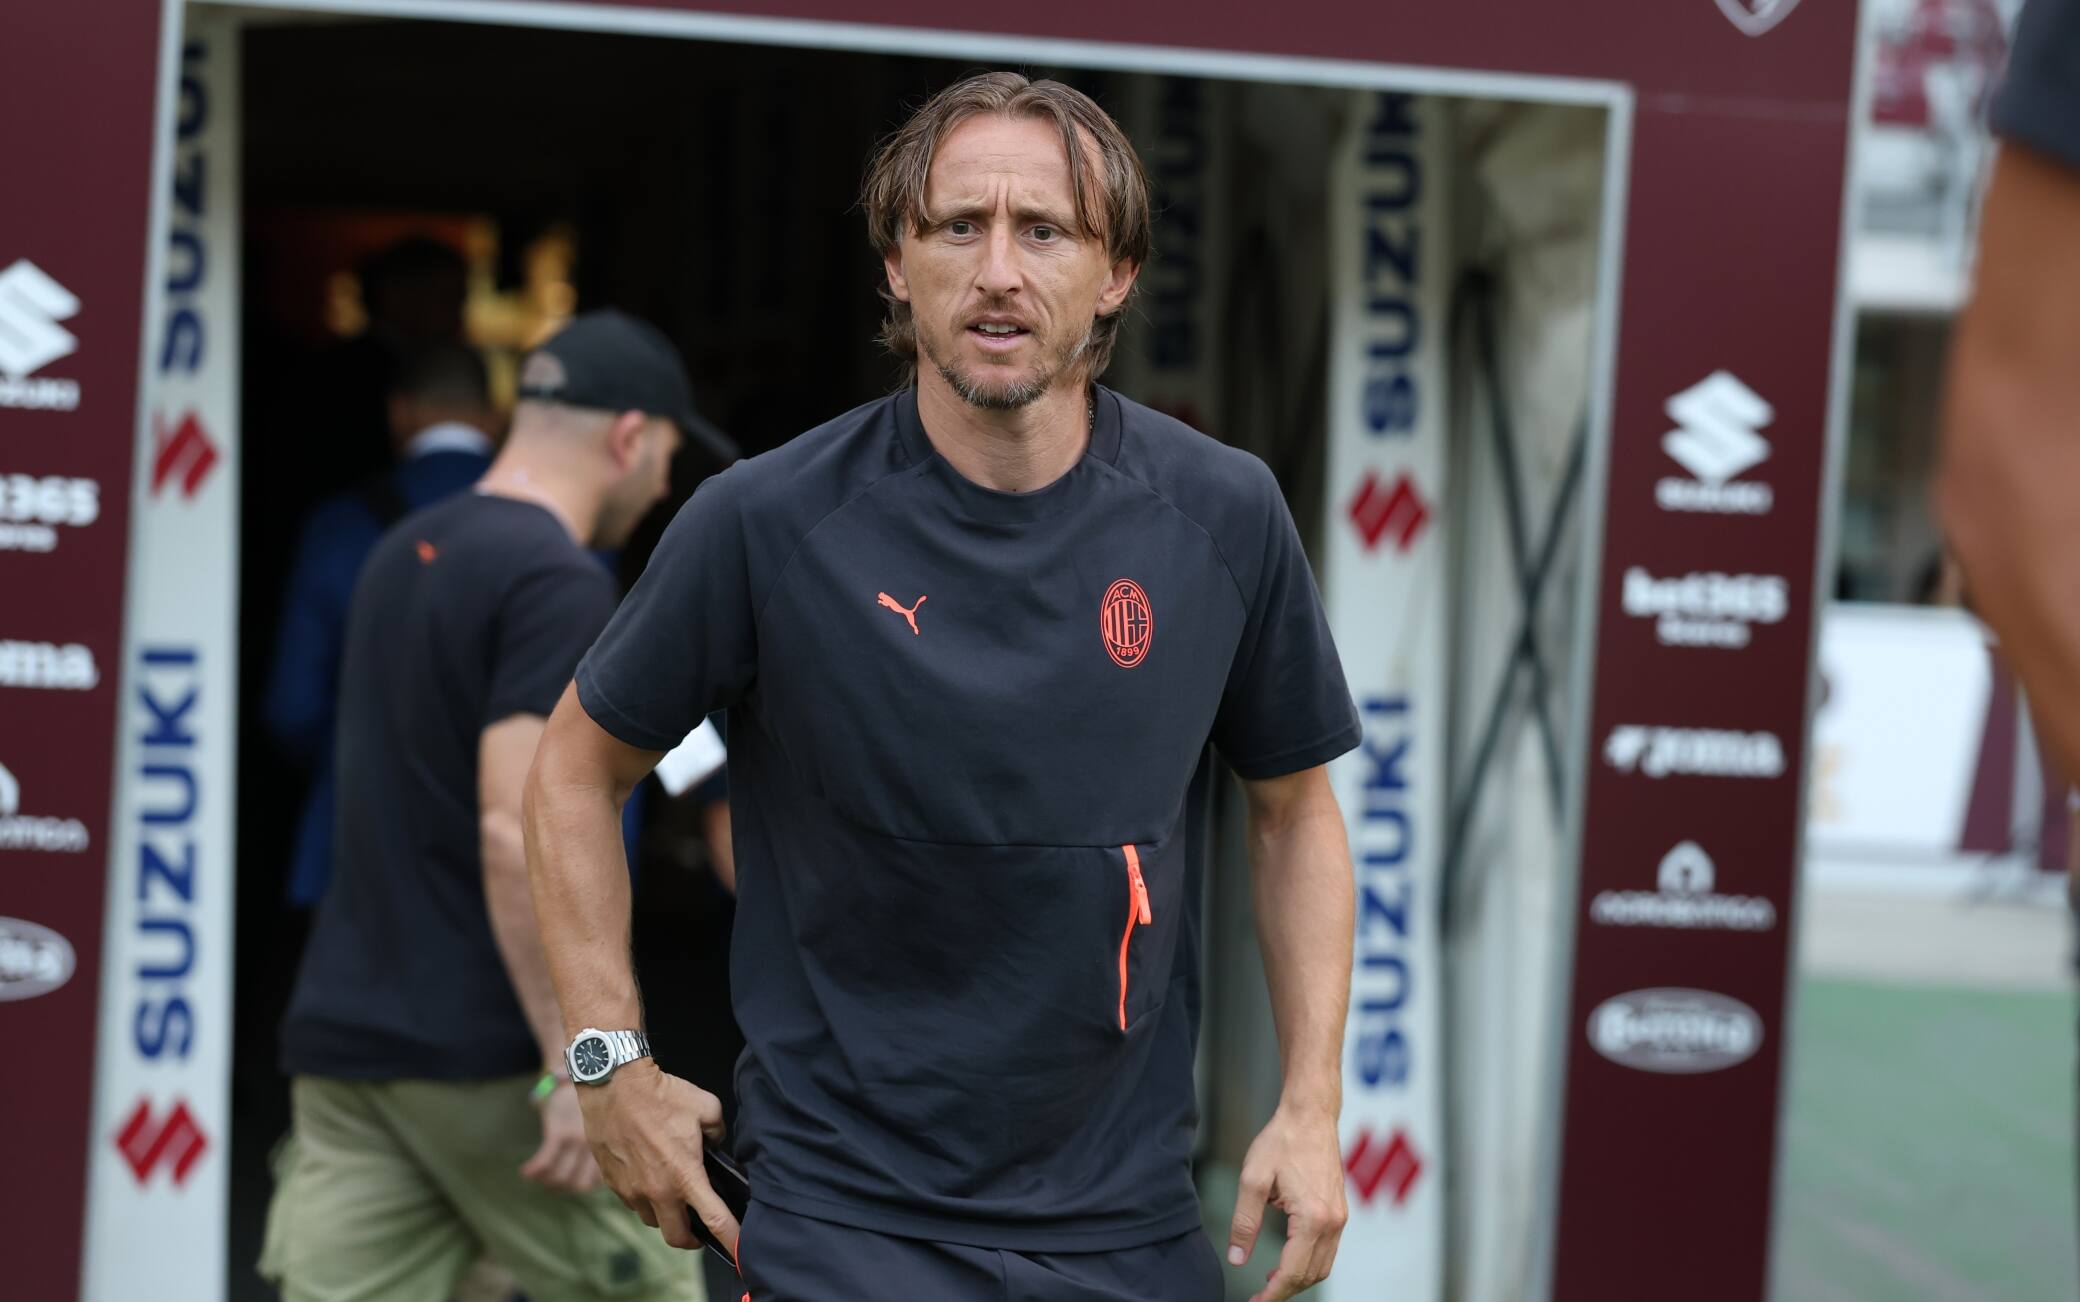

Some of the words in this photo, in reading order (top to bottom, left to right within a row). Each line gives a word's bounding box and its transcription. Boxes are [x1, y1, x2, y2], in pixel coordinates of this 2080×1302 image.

[0, 474, 99, 525] 365
[1112, 586, 1139, 602] ACM
[1116, 646, 1140, 657] 1899
[136, 648, 199, 1061] SUZUKI
[1355, 697, 1412, 1087] SUZUKI
